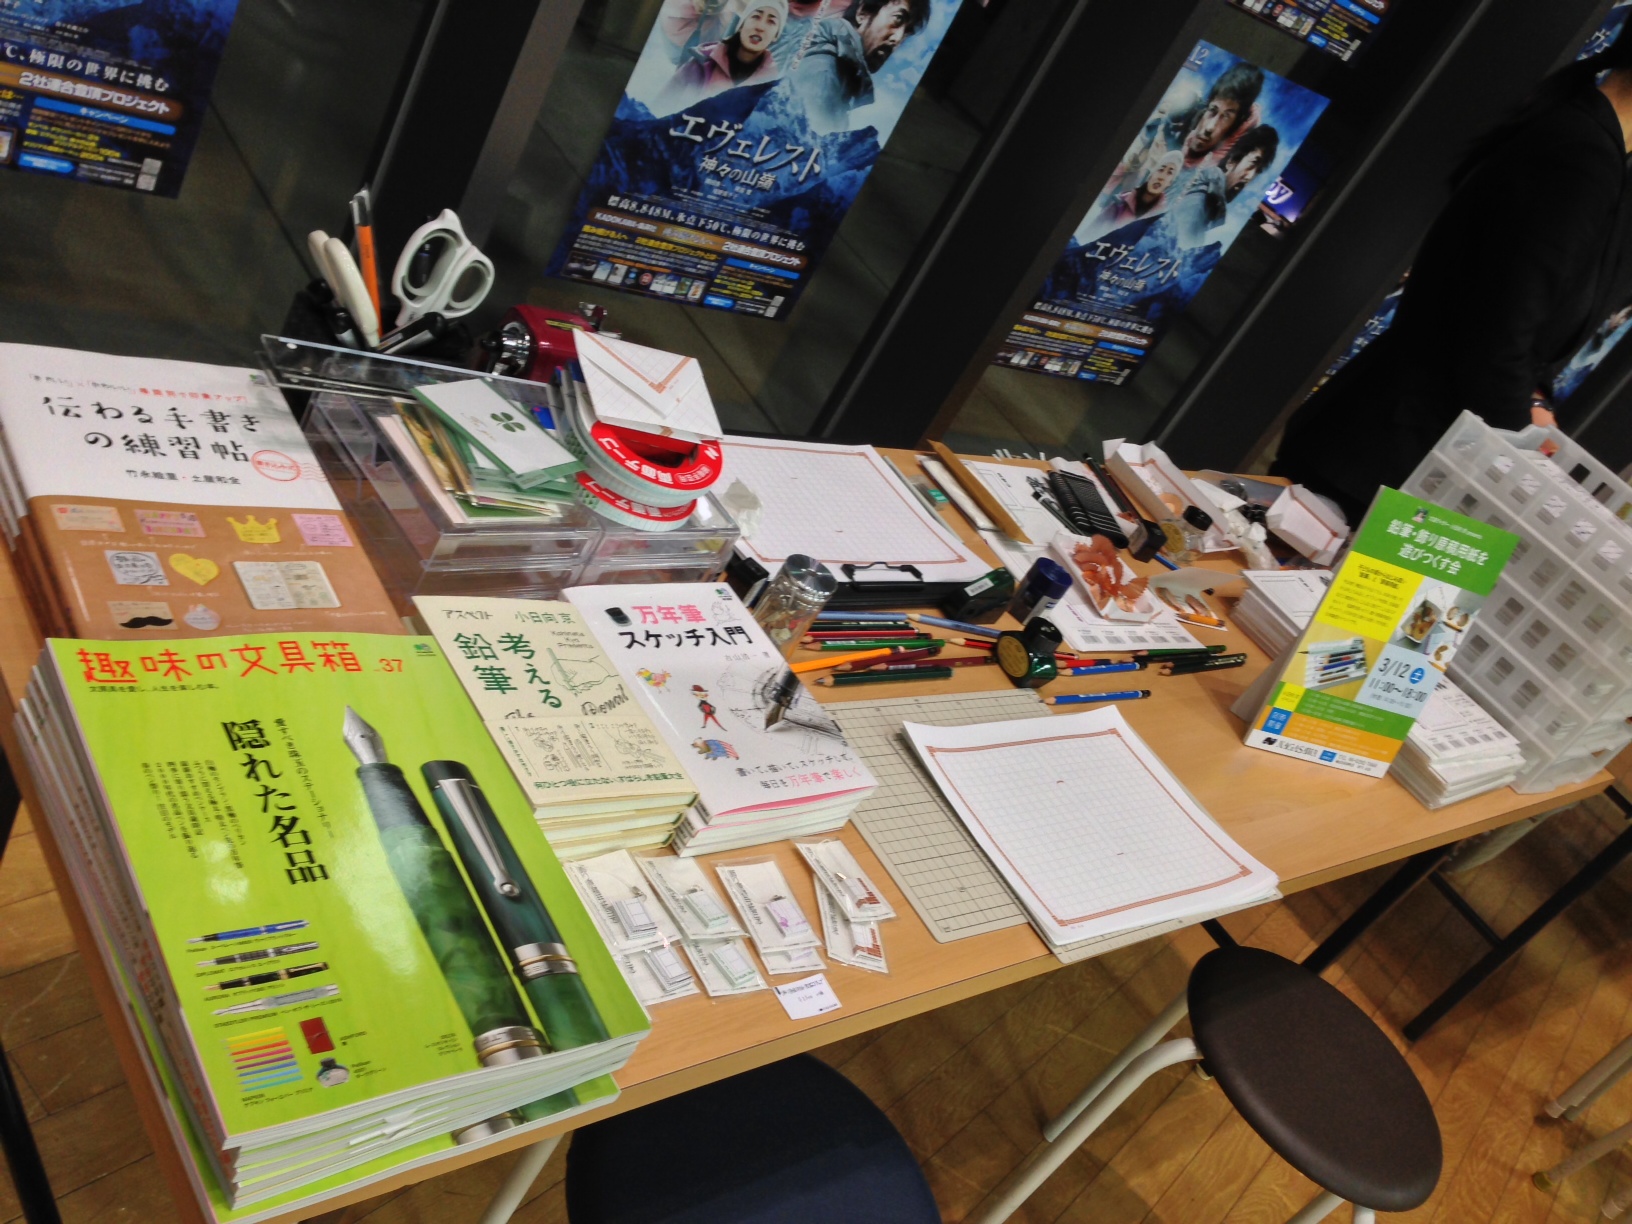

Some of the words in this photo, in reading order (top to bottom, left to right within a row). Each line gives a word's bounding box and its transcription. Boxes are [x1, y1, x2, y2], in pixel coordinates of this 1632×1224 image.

[669, 113, 822, 182] エヴェレスト
[699, 154, 777, 192] 神々の山嶺
[1085, 241, 1181, 284] エヴェレスト
[42, 397, 261, 433] 伝わる手書き
[84, 430, 250, 463] の練習帖
[1397, 542, 1462, 576] 遊びつくす会
[442, 609, 494, 621] アスペクト
[514, 611, 576, 625] 小日向京
[632, 603, 707, 625] 万年筆
[618, 625, 753, 650] スケッチ入門
[76, 640, 363, 683] 趣味の文具箱
[453, 632, 518, 694] 鉛筆
[497, 632, 562, 709] 考える
[1378, 657, 1411, 679] 3/12
[760, 767, 862, 789] 毎日を万年筆で楽しく
[220, 718, 329, 885] 隠れた名品
